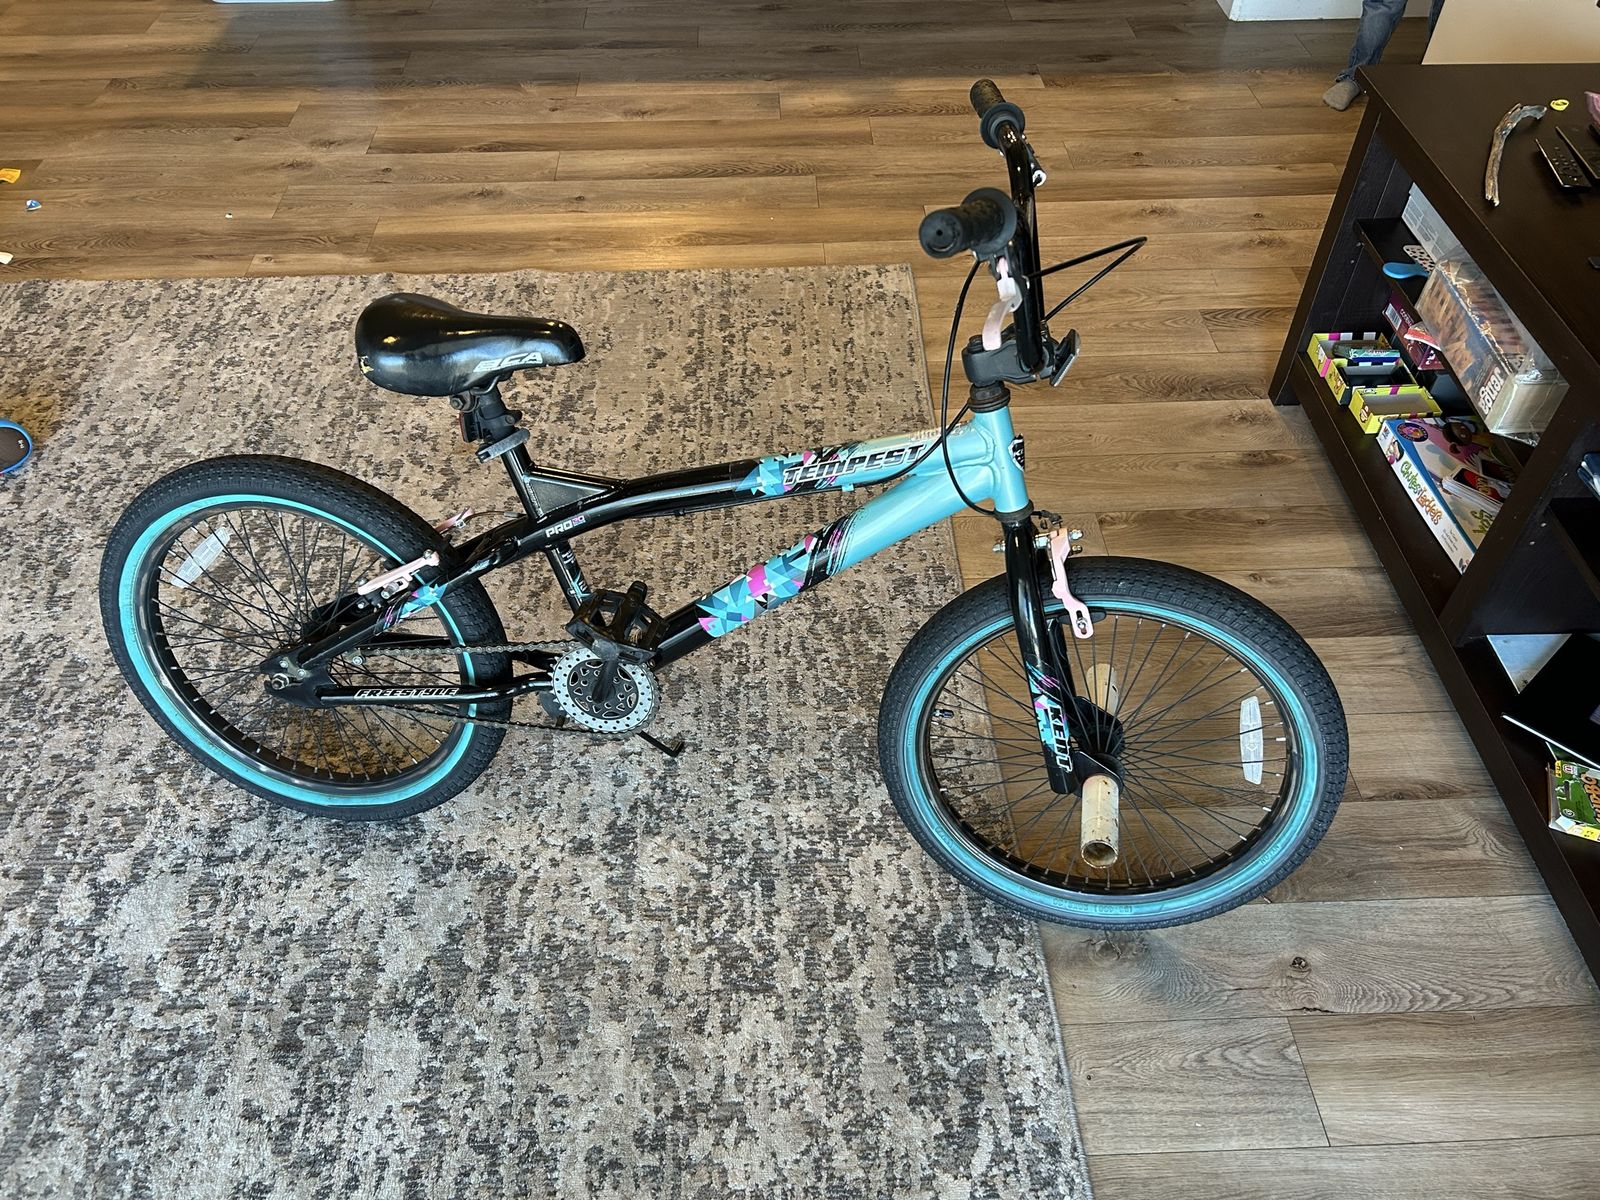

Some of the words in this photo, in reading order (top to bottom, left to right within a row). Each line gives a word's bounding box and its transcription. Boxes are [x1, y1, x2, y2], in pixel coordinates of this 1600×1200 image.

[1478, 366, 1504, 414] Jenga
[783, 444, 927, 485] TEMPEST
[354, 688, 459, 699] FREESTYLE
[1047, 704, 1073, 773] KENT
